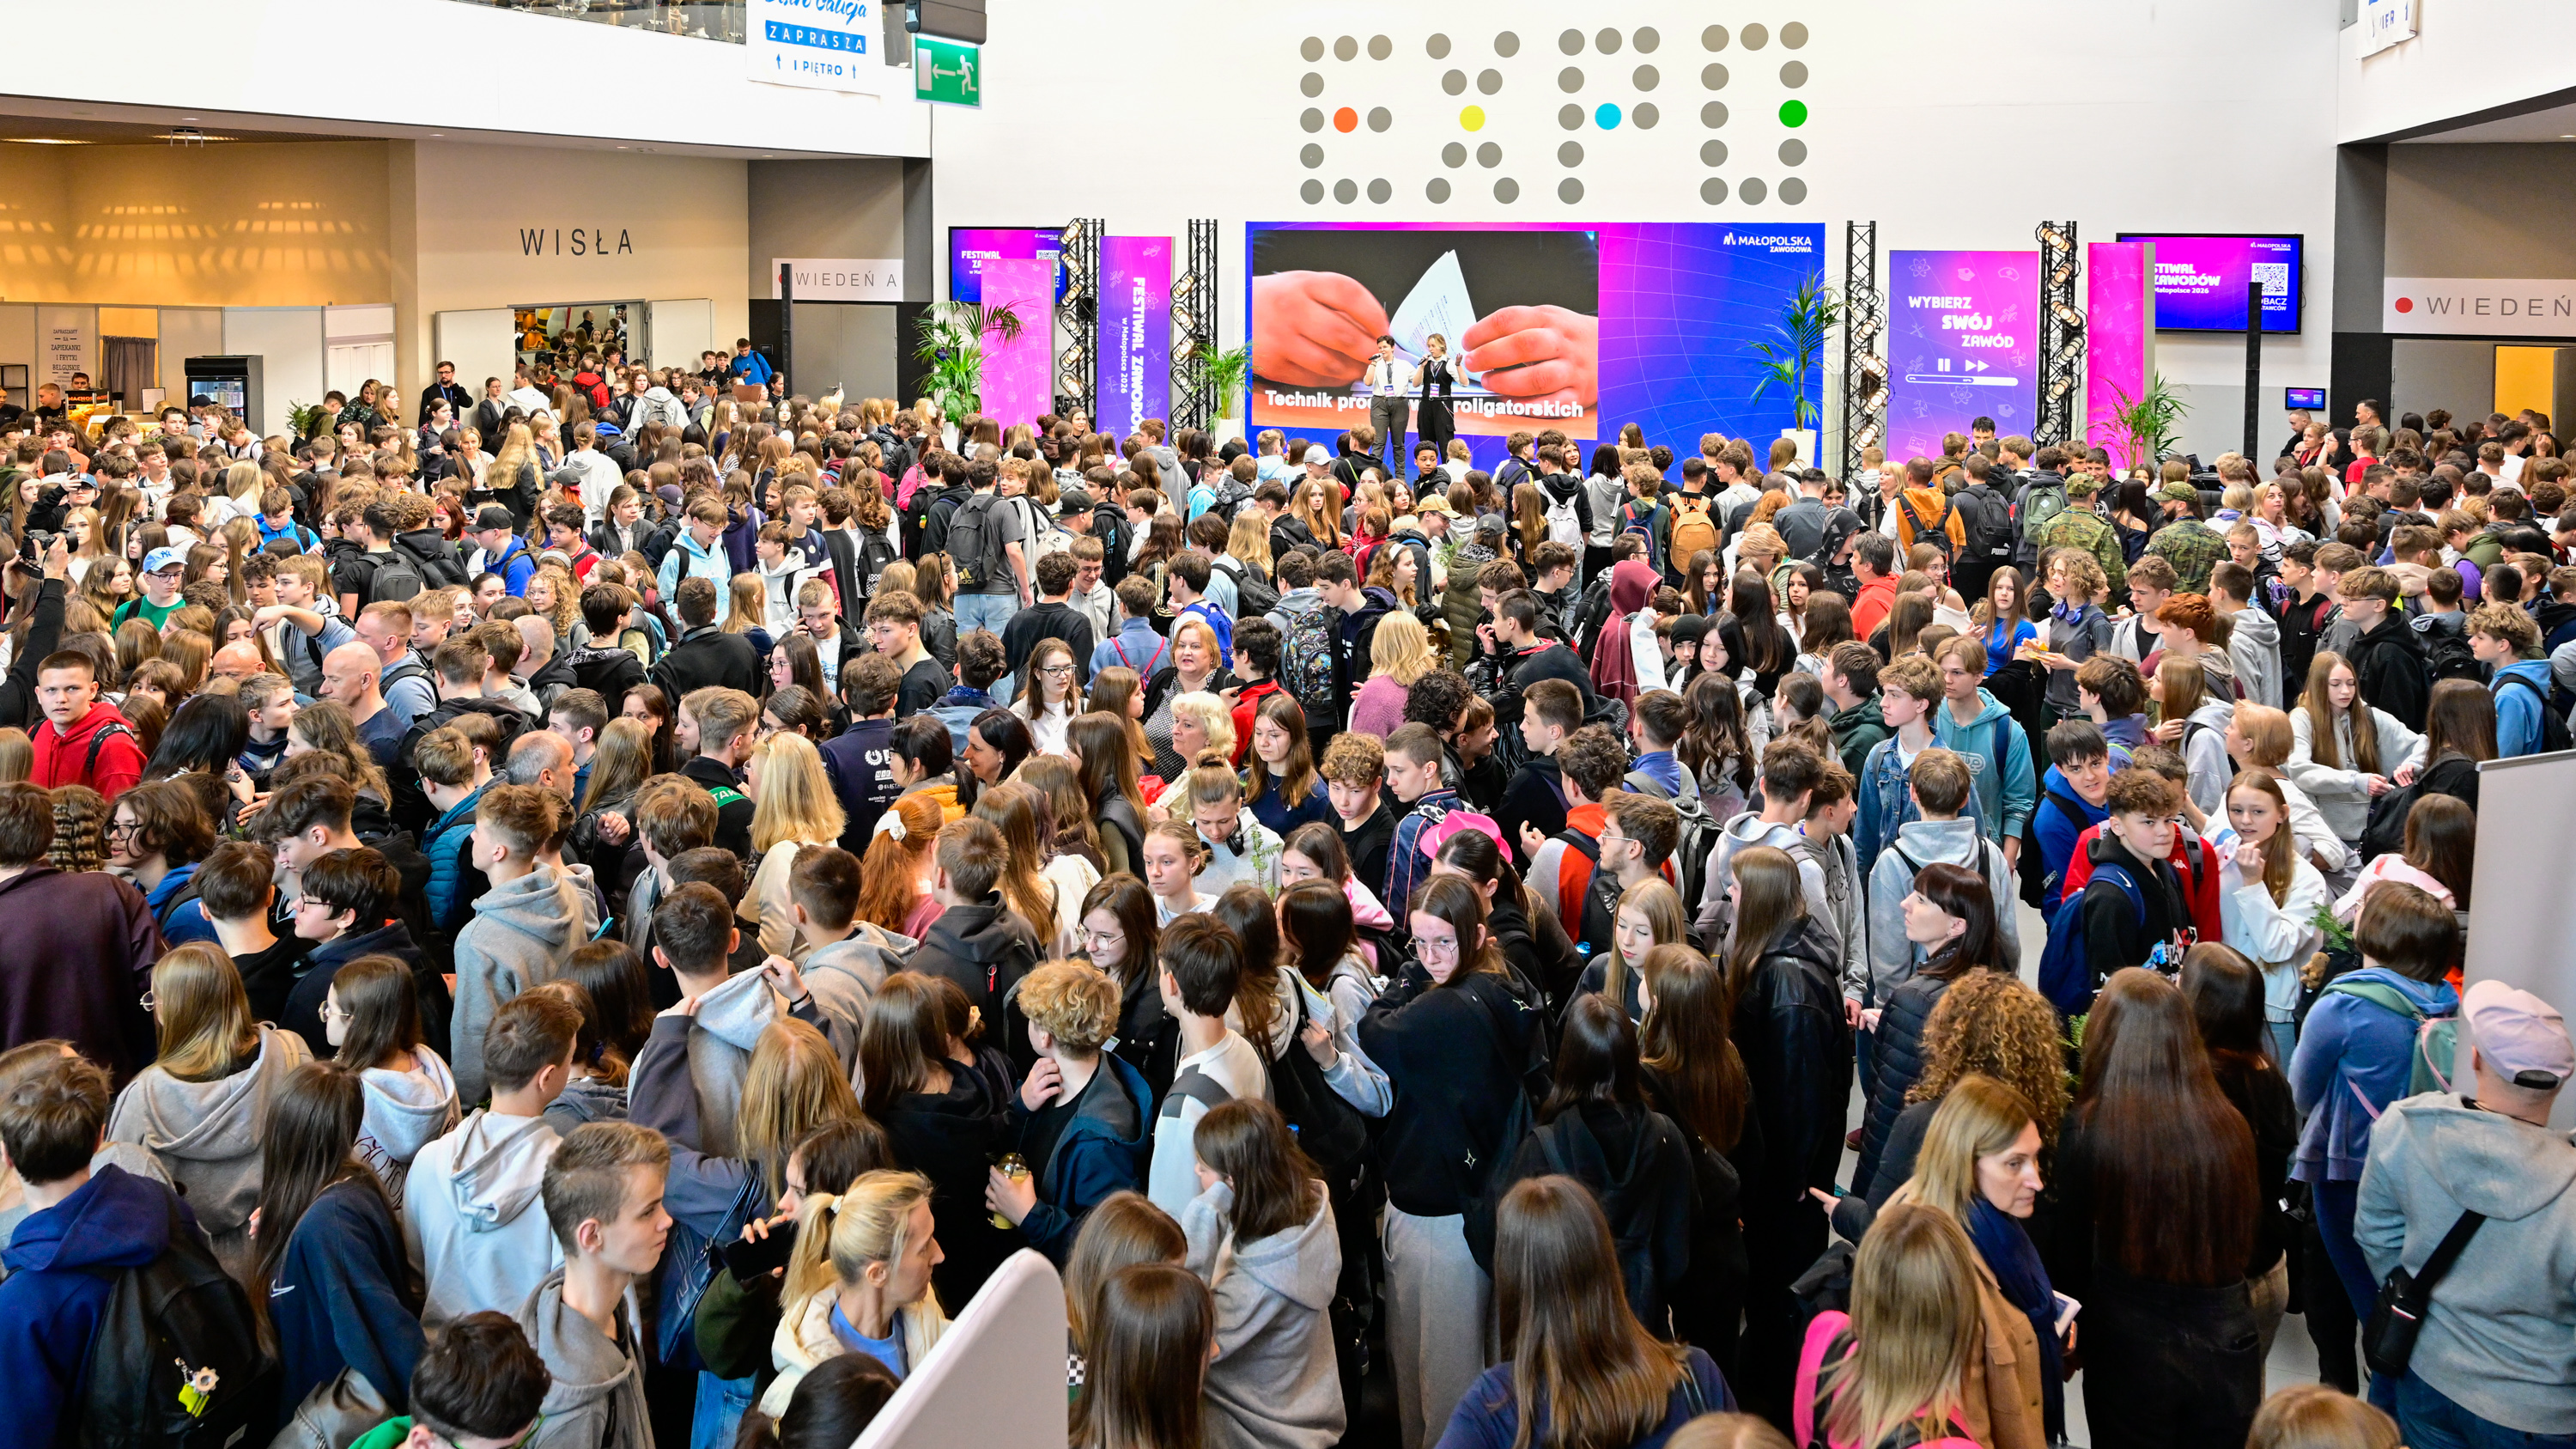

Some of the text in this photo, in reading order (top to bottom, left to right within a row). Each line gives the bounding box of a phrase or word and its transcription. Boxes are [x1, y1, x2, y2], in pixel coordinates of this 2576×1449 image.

[769, 25, 863, 52] ZAPRASZA
[803, 60, 842, 76] PIĘTRO
[519, 228, 633, 257] WISŁA
[1738, 235, 1813, 246] MAŁOPOLSKA
[961, 250, 1001, 259] FESTIWAL
[2154, 263, 2196, 274] TIWAL
[795, 270, 897, 288] WIEDEŃ A
[1907, 295, 1972, 309] WYBIERZ
[2426, 294, 2573, 317] WIEDEŃ
[1132, 277, 1145, 351] FESTIWAL
[1941, 312, 1993, 331] SWÓJ
[1119, 326, 1129, 371] Małopolsce
[1960, 332, 2014, 348] ZAWÓD
[1120, 373, 1128, 394] 2026
[1265, 391, 1333, 408] Technik
